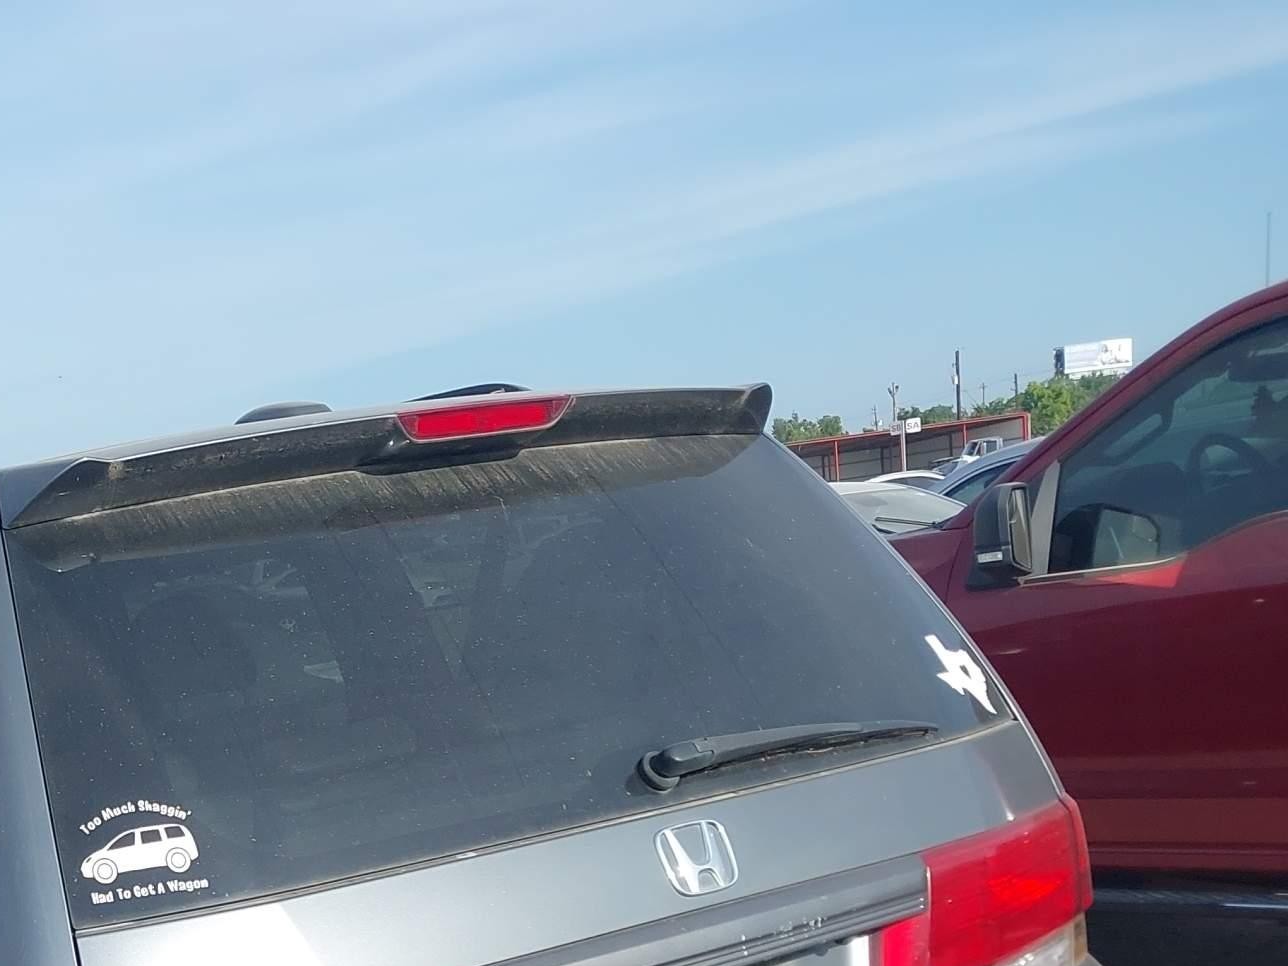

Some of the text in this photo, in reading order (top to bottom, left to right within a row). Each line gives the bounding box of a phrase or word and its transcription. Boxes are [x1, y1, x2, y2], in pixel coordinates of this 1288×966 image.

[79, 800, 192, 836] Too Much Shaggin'
[90, 878, 209, 905] Had To Get A Wagon
